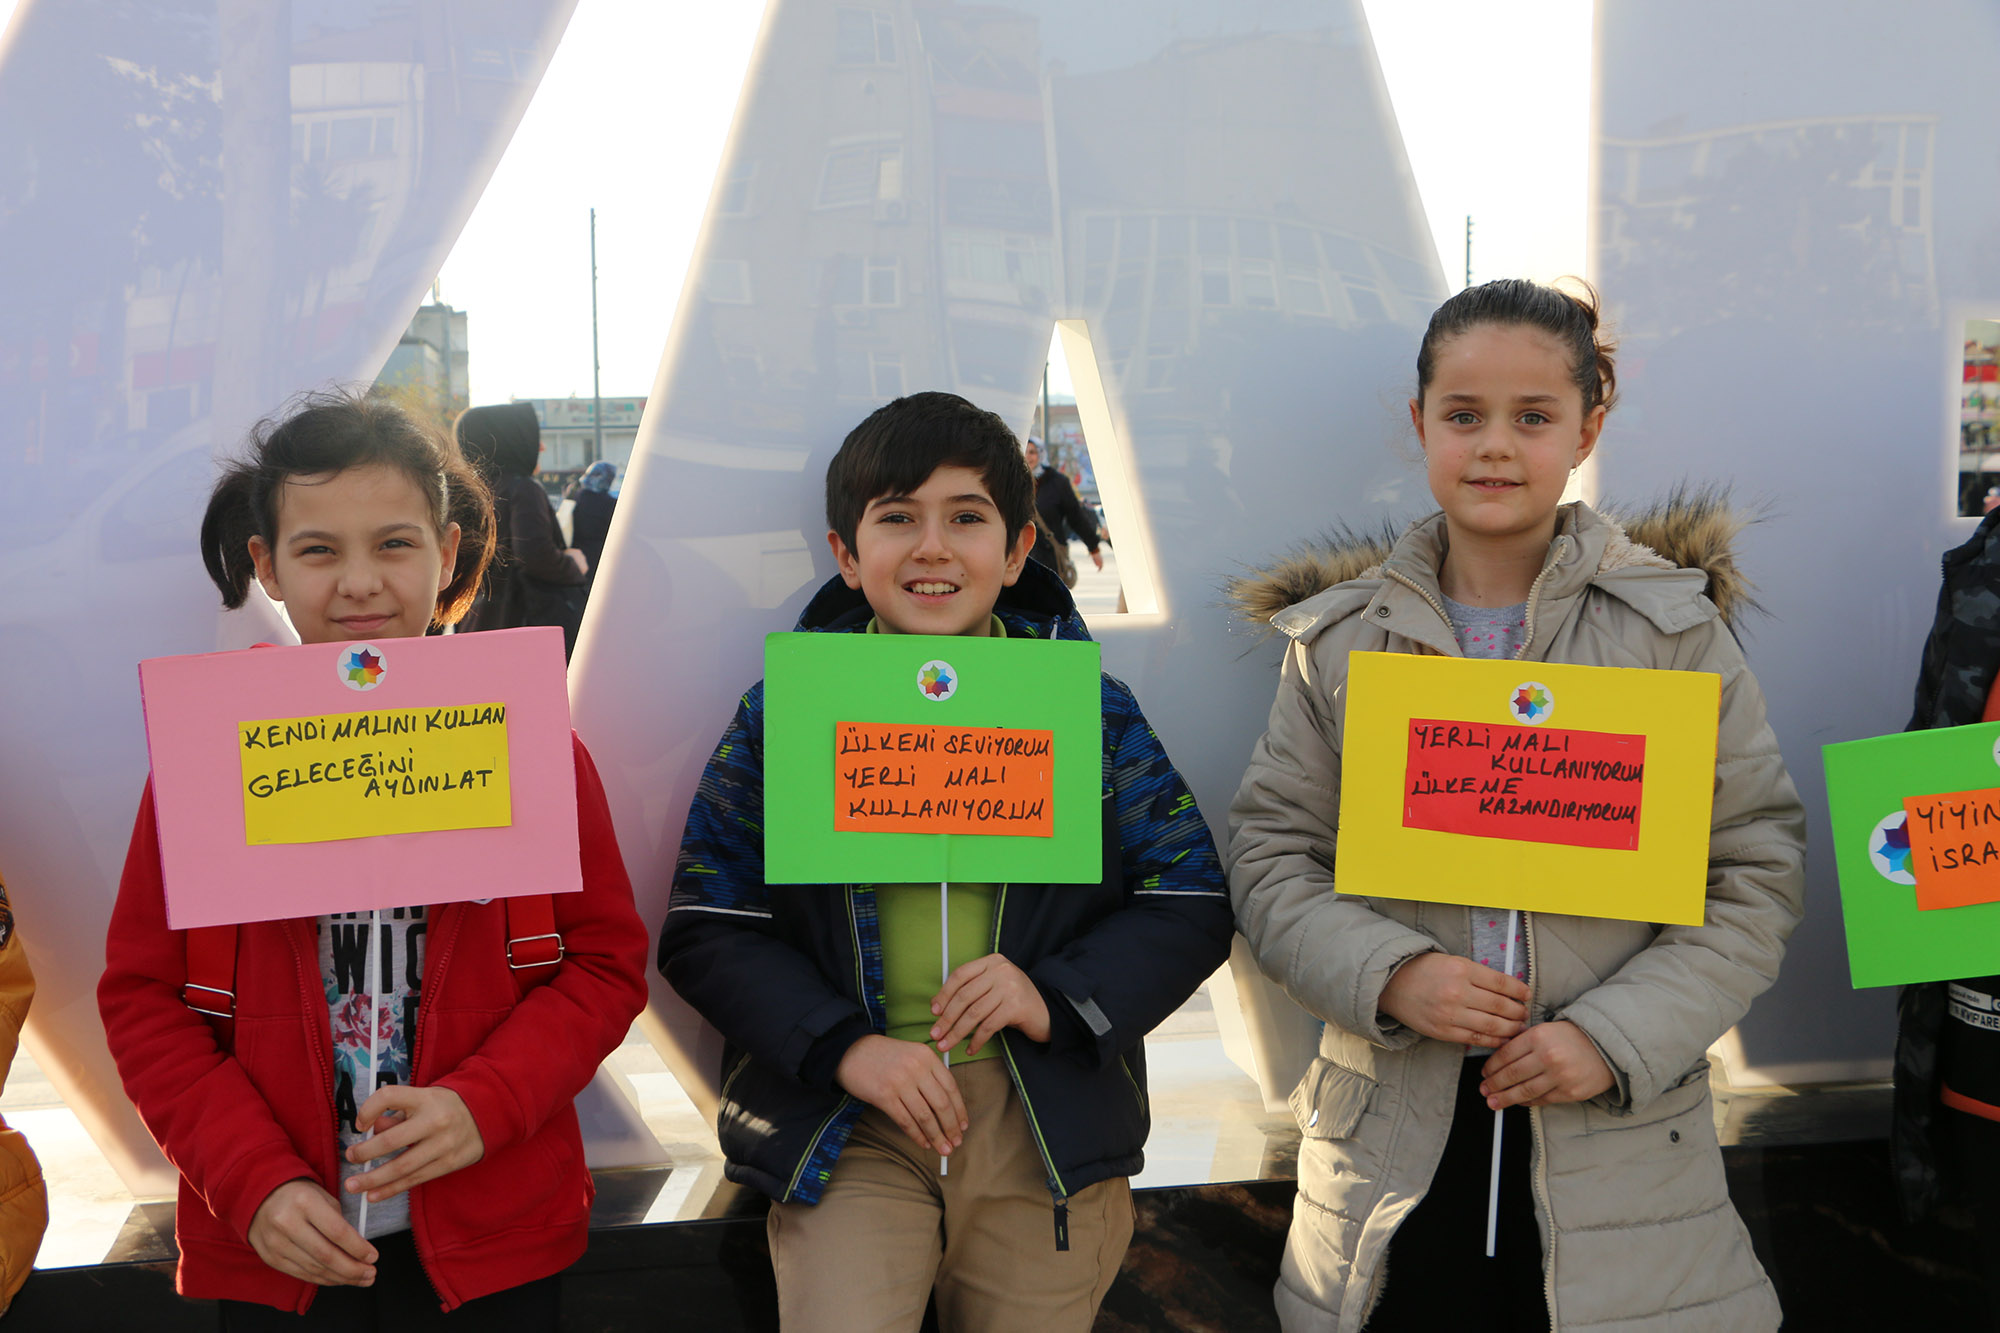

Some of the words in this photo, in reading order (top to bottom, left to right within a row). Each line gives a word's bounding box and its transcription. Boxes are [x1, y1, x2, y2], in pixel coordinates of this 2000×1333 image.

[244, 718, 326, 749] KENDİ
[331, 714, 417, 742] MALINI
[425, 706, 506, 733] KULLAN
[840, 727, 936, 755] ÜLKEMİ
[1414, 726, 1490, 749] YERLİ
[1502, 733, 1570, 753] MALI
[843, 765, 916, 789] YERLİ
[944, 766, 1006, 788] MALI
[1491, 753, 1644, 783] KULLANIYORUM
[364, 769, 493, 798] AYDINLAT
[1411, 770, 1524, 796] ÜLKEME
[849, 798, 1045, 821] KULLANIYORUM
[1479, 797, 1637, 824] KAZANDIRIYORUM
